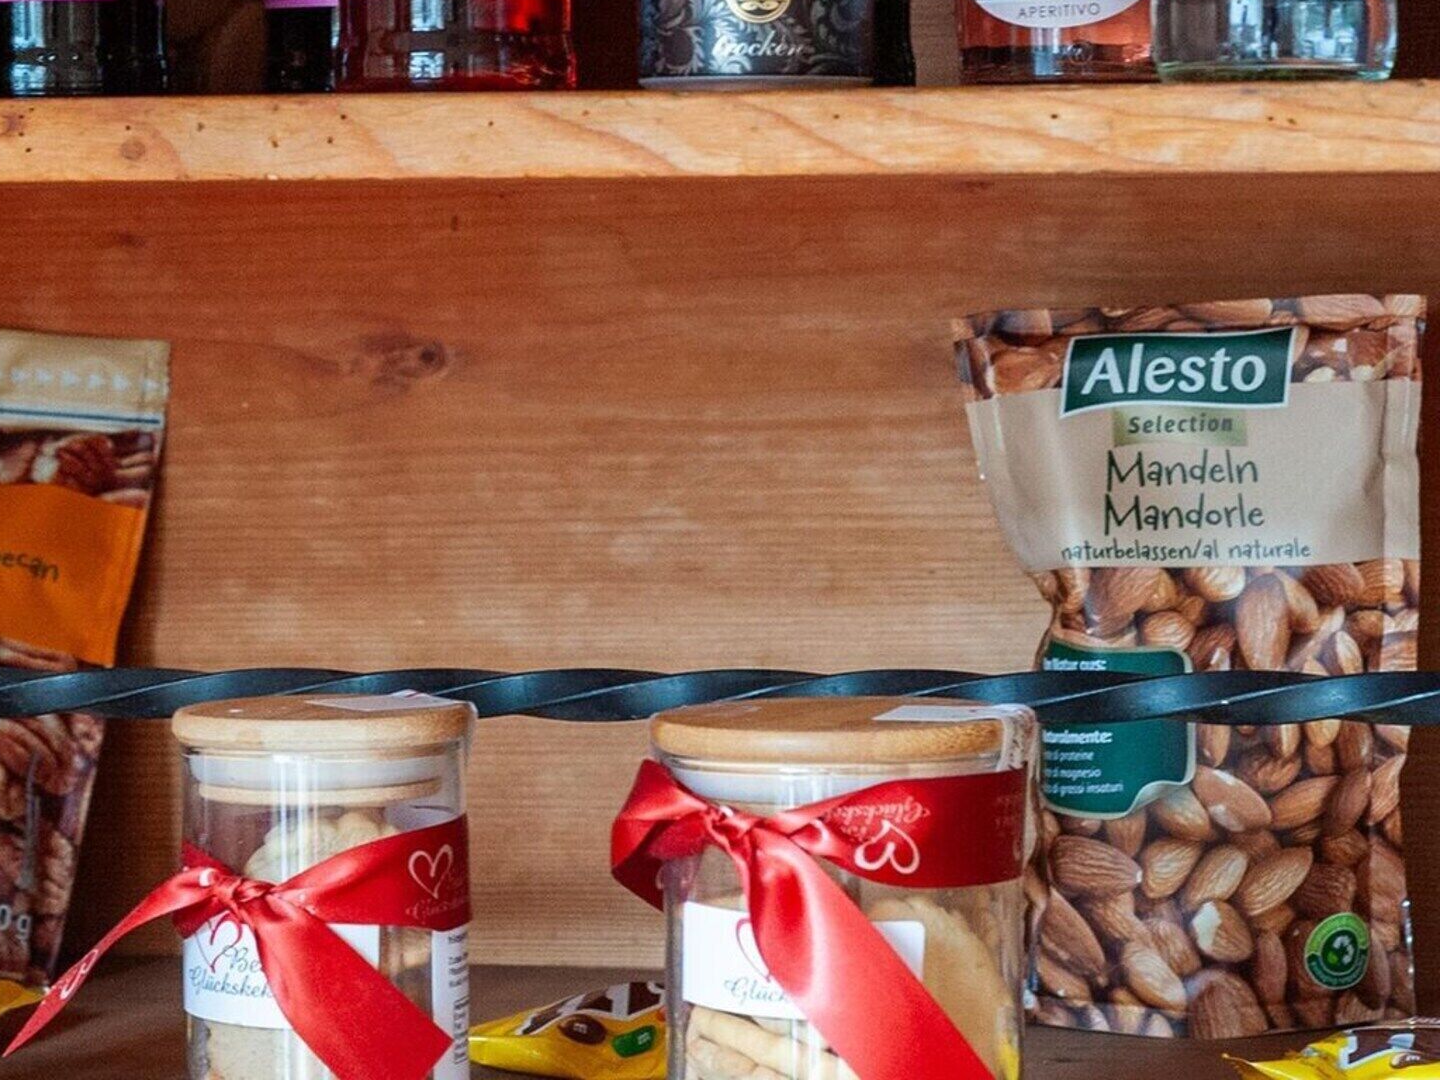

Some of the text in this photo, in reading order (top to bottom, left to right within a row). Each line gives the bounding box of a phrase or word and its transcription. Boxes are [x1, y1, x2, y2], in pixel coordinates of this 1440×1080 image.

[1017, 2, 1101, 19] APERITIVO
[1080, 343, 1267, 397] Alesto
[1128, 414, 1233, 435] Selection
[1106, 448, 1259, 493] Mandeln
[1103, 492, 1265, 537] Mandorle
[1060, 537, 1312, 564] naturbelassen/al naturale
[17, 914, 32, 941] g
